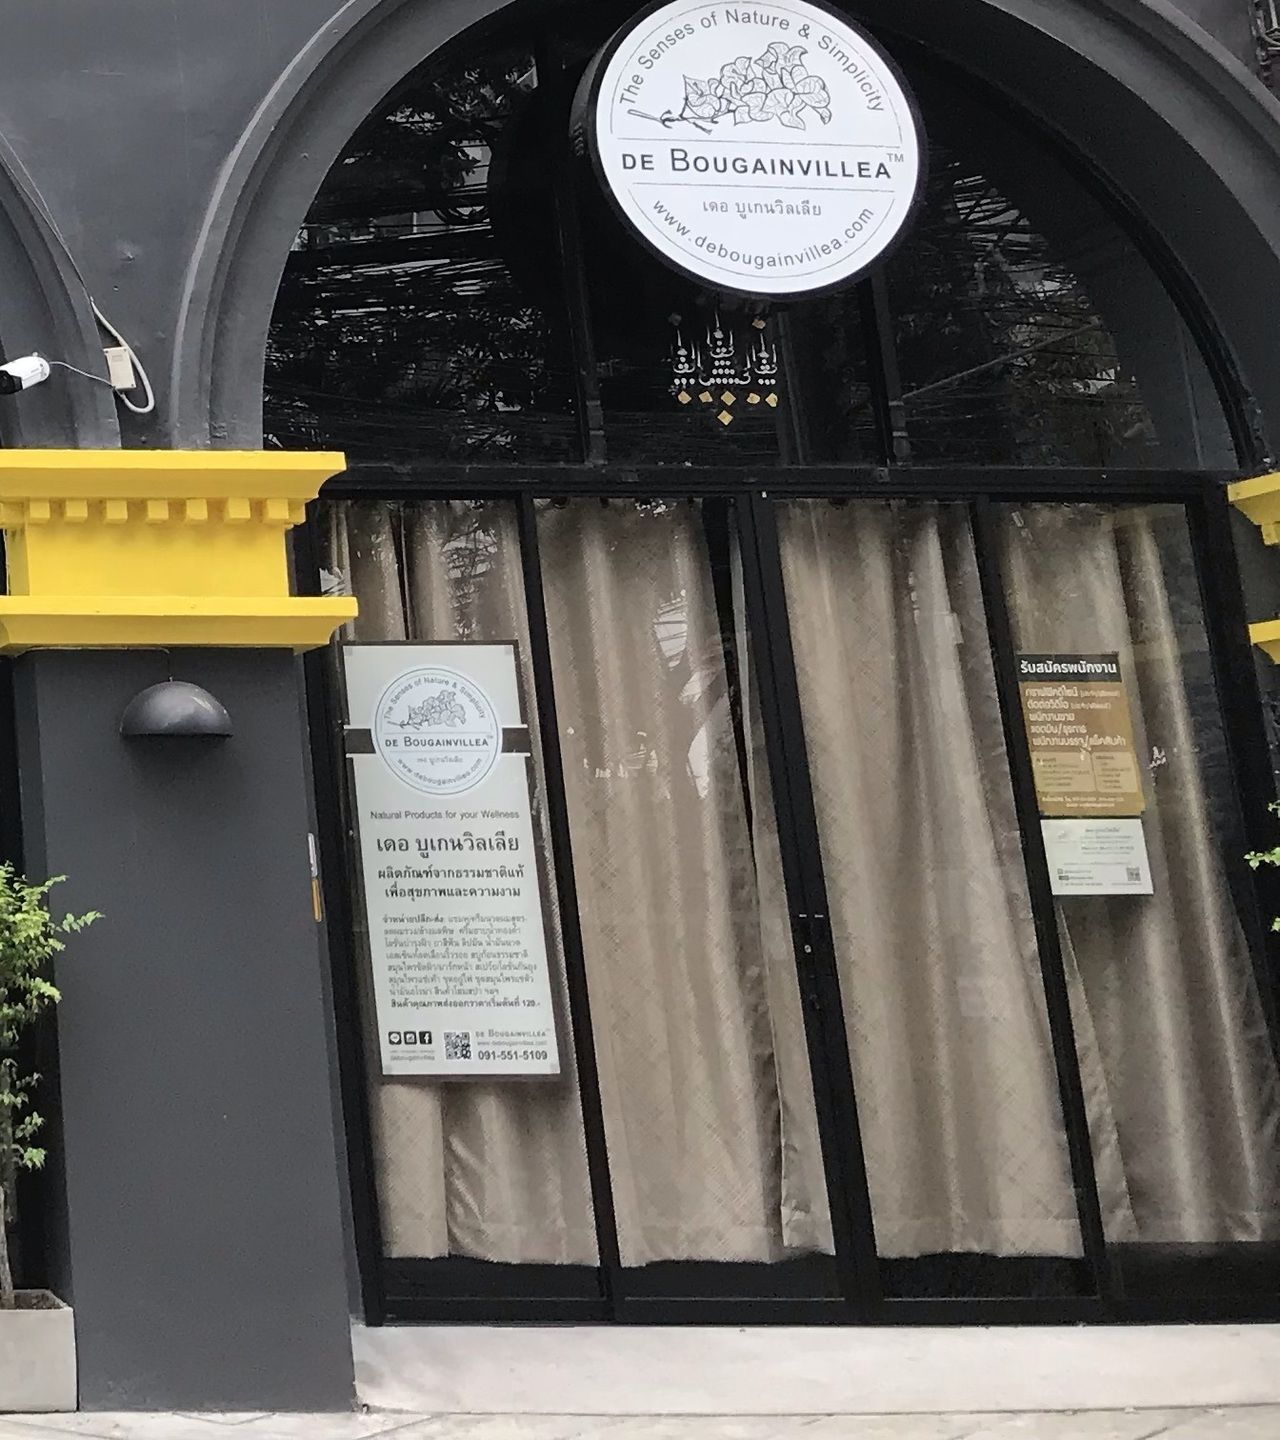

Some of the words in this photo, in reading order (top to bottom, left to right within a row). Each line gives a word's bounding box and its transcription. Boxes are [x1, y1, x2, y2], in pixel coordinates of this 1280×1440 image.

[620, 72, 644, 106] The
[639, 21, 695, 69] Senses
[701, 11, 718, 29] of
[726, 8, 790, 30] Nature
[798, 24, 810, 39] &
[818, 36, 884, 113] Simplicity
[622, 153, 655, 171] DE
[670, 148, 891, 179] BOUGAINVILLEA
[703, 200, 729, 213] เดอ
[735, 199, 822, 219] บูเกนวิลเลีย
[652, 199, 874, 270] www.debougainvillea.com
[1020, 660, 1117, 674] รับสมัครพนักงาน
[385, 739, 398, 747] DE
[404, 736, 489, 747] BOUGAINVILLEA
[370, 811, 402, 819] Natural
[405, 811, 442, 819] Products
[445, 810, 456, 819] for
[460, 812, 479, 821] your
[481, 810, 520, 819] Wellness
[377, 838, 409, 852] เดอ
[416, 830, 519, 859] บูเกนวิลเลีย
[378, 865, 525, 880] ผลิตภัณฑ์จากธรรมชาติแท้
[385, 884, 521, 903] เพื่อสุขภาพและความงาม
[478, 1050, 548, 1061] 091-551-5109
